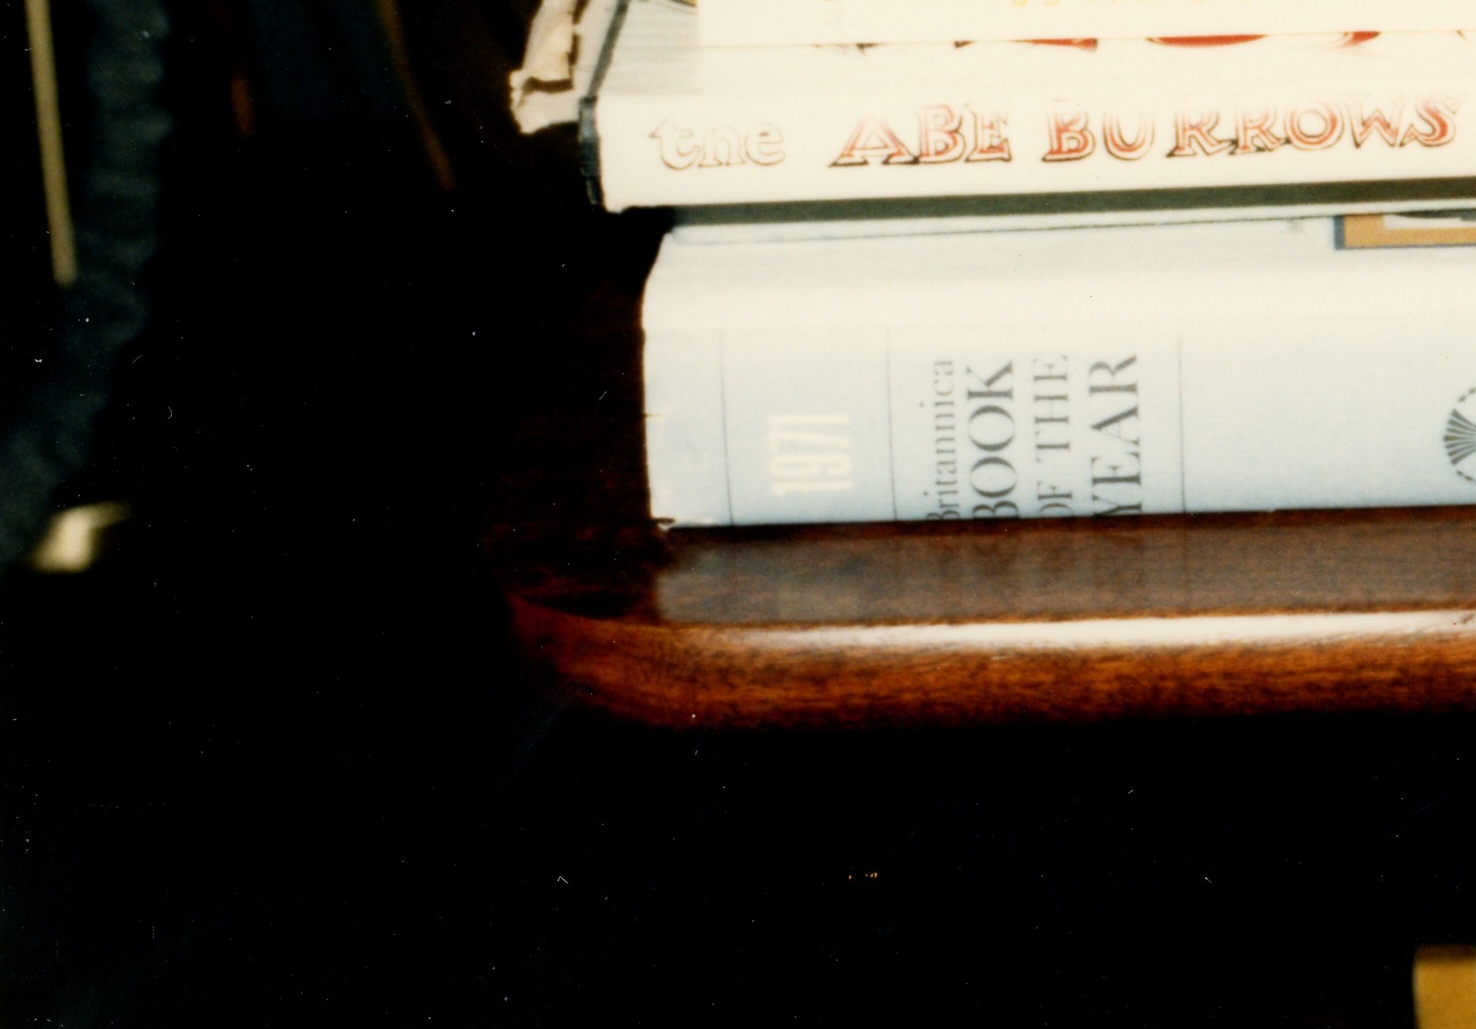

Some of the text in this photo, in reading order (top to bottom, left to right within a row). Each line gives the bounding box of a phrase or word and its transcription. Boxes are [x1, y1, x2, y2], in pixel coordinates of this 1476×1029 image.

[828, 99, 1013, 169] ABE
[1041, 88, 1464, 163] BURROWS
[769, 412, 854, 498] 1971
[965, 358, 1020, 518] BOOK
[1032, 353, 1070, 463] THE
[1088, 353, 1142, 515] YEAR
